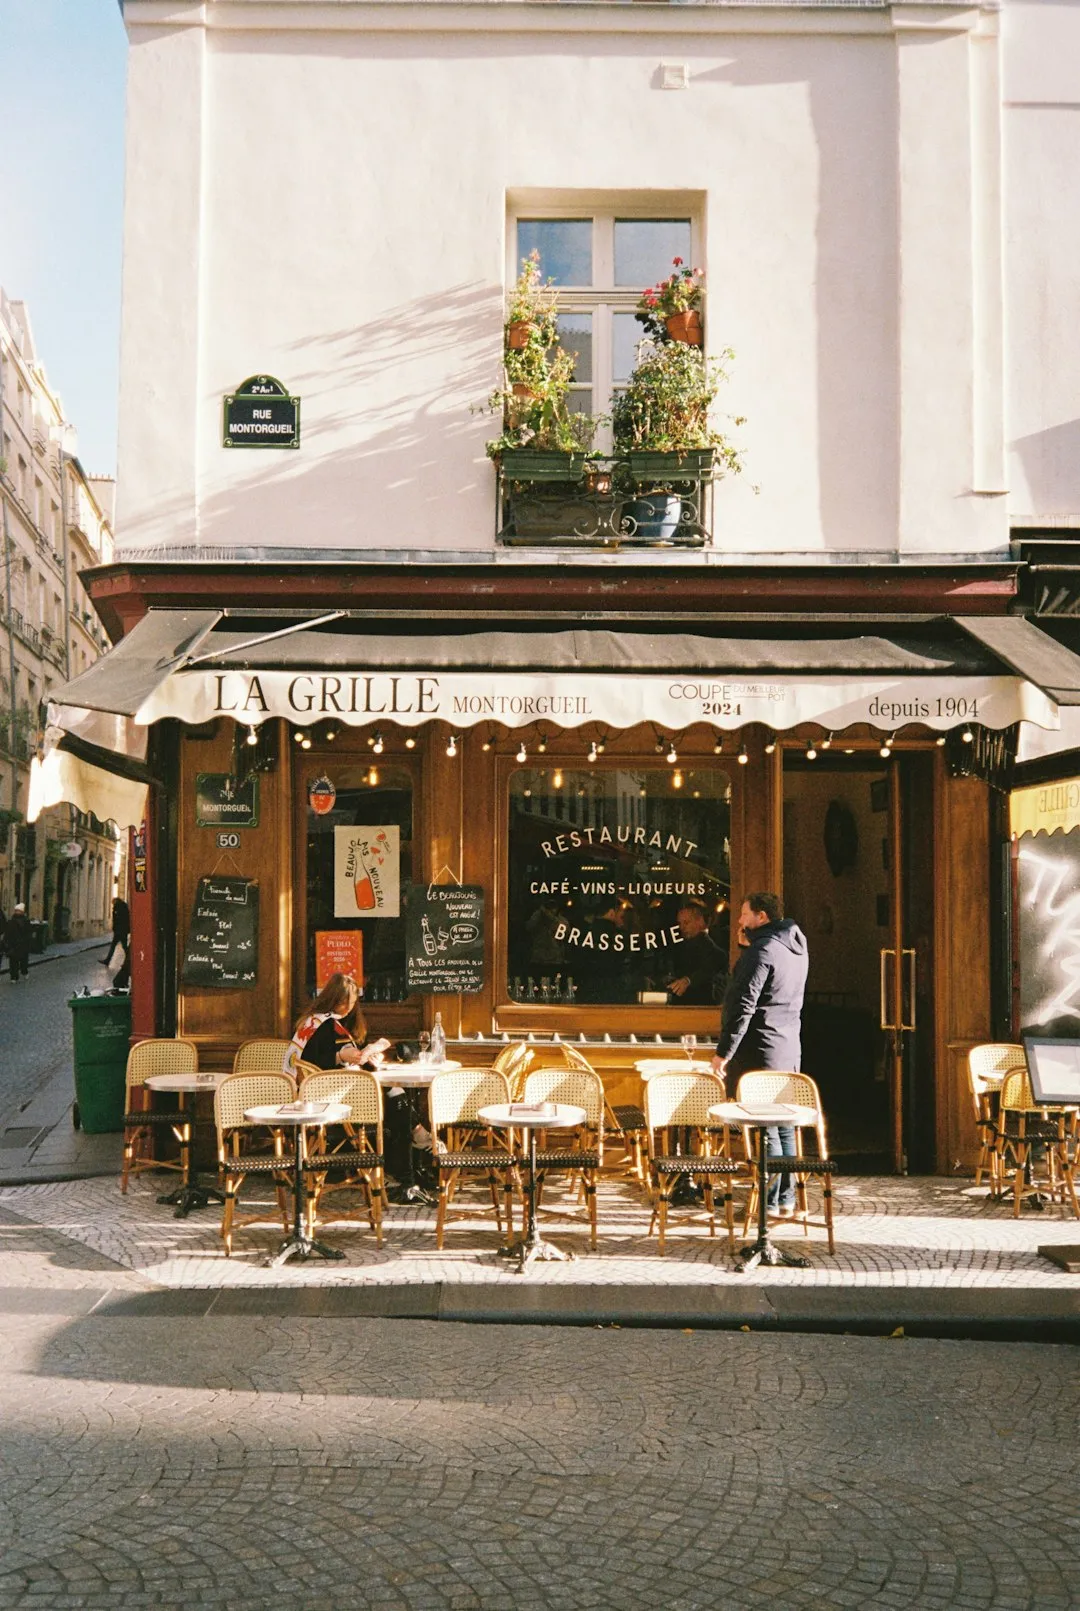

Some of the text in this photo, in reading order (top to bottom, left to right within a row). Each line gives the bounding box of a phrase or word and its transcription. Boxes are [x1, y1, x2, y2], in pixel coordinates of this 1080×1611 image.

[252, 409, 272, 419] RUE
[229, 423, 294, 433] MONTORGUEIL
[213, 675, 592, 715] LA GRILLE MONTORGUEIL
[668, 684, 732, 700] COUPE
[768, 693, 785, 701] POT
[702, 702, 741, 716] 2024
[868, 696, 980, 720] depuis 1904
[202, 804, 251, 813] MONTORGUEIL
[219, 834, 238, 847] 50
[541, 826, 698, 858] RESTAURANT
[345, 838, 369, 877] BEAUJOLAIS
[369, 867, 385, 908] NOUVEAU
[554, 923, 684, 951] BRASSERIE
